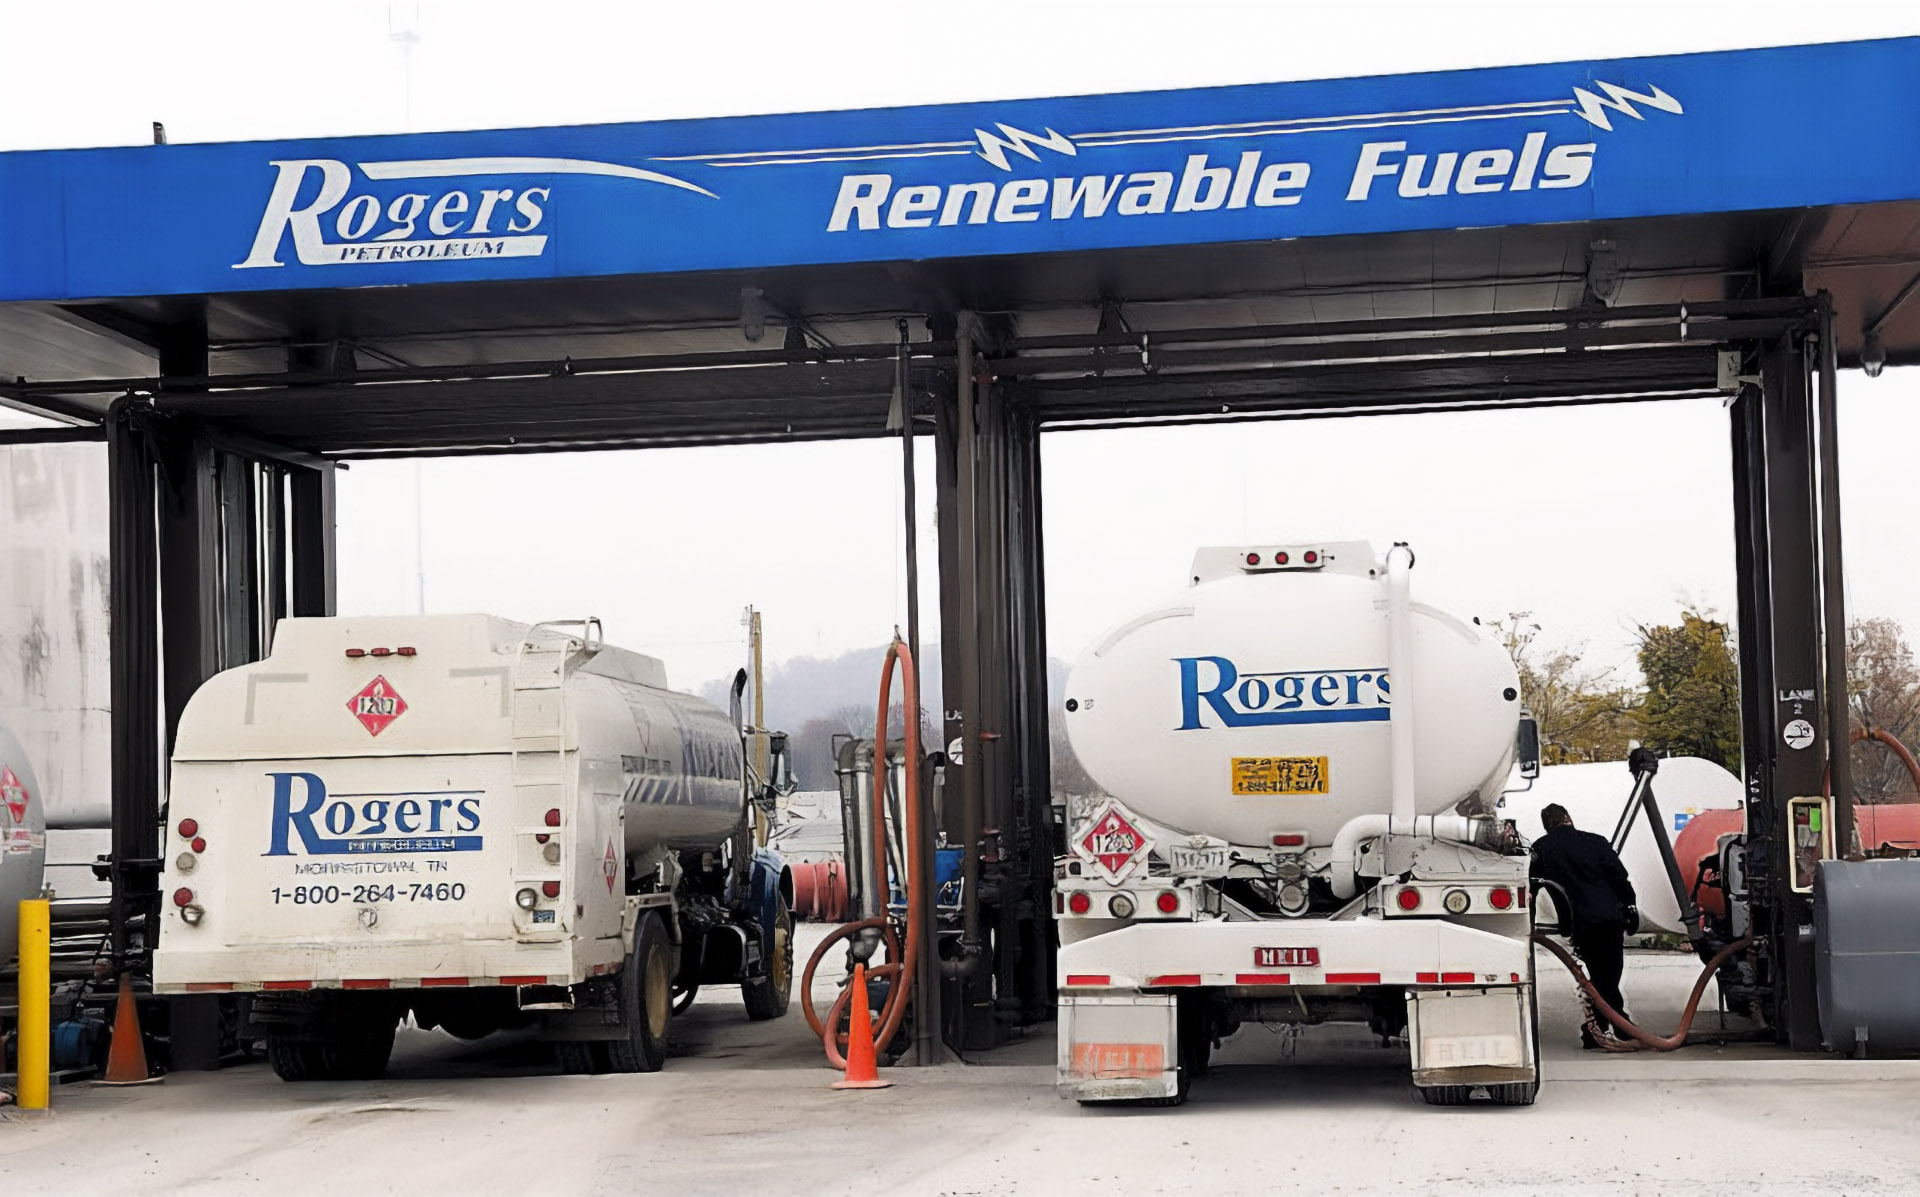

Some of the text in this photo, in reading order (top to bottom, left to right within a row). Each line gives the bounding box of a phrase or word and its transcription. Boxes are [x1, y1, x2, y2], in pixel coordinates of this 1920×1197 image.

[231, 158, 552, 270] Rogers
[827, 131, 1597, 232] Renewable Fuels
[340, 241, 505, 261] PETROLEUM
[1170, 655, 1392, 731] Rogers
[261, 772, 484, 856] Rogers
[271, 882, 466, 905] 1-800-264-7460
